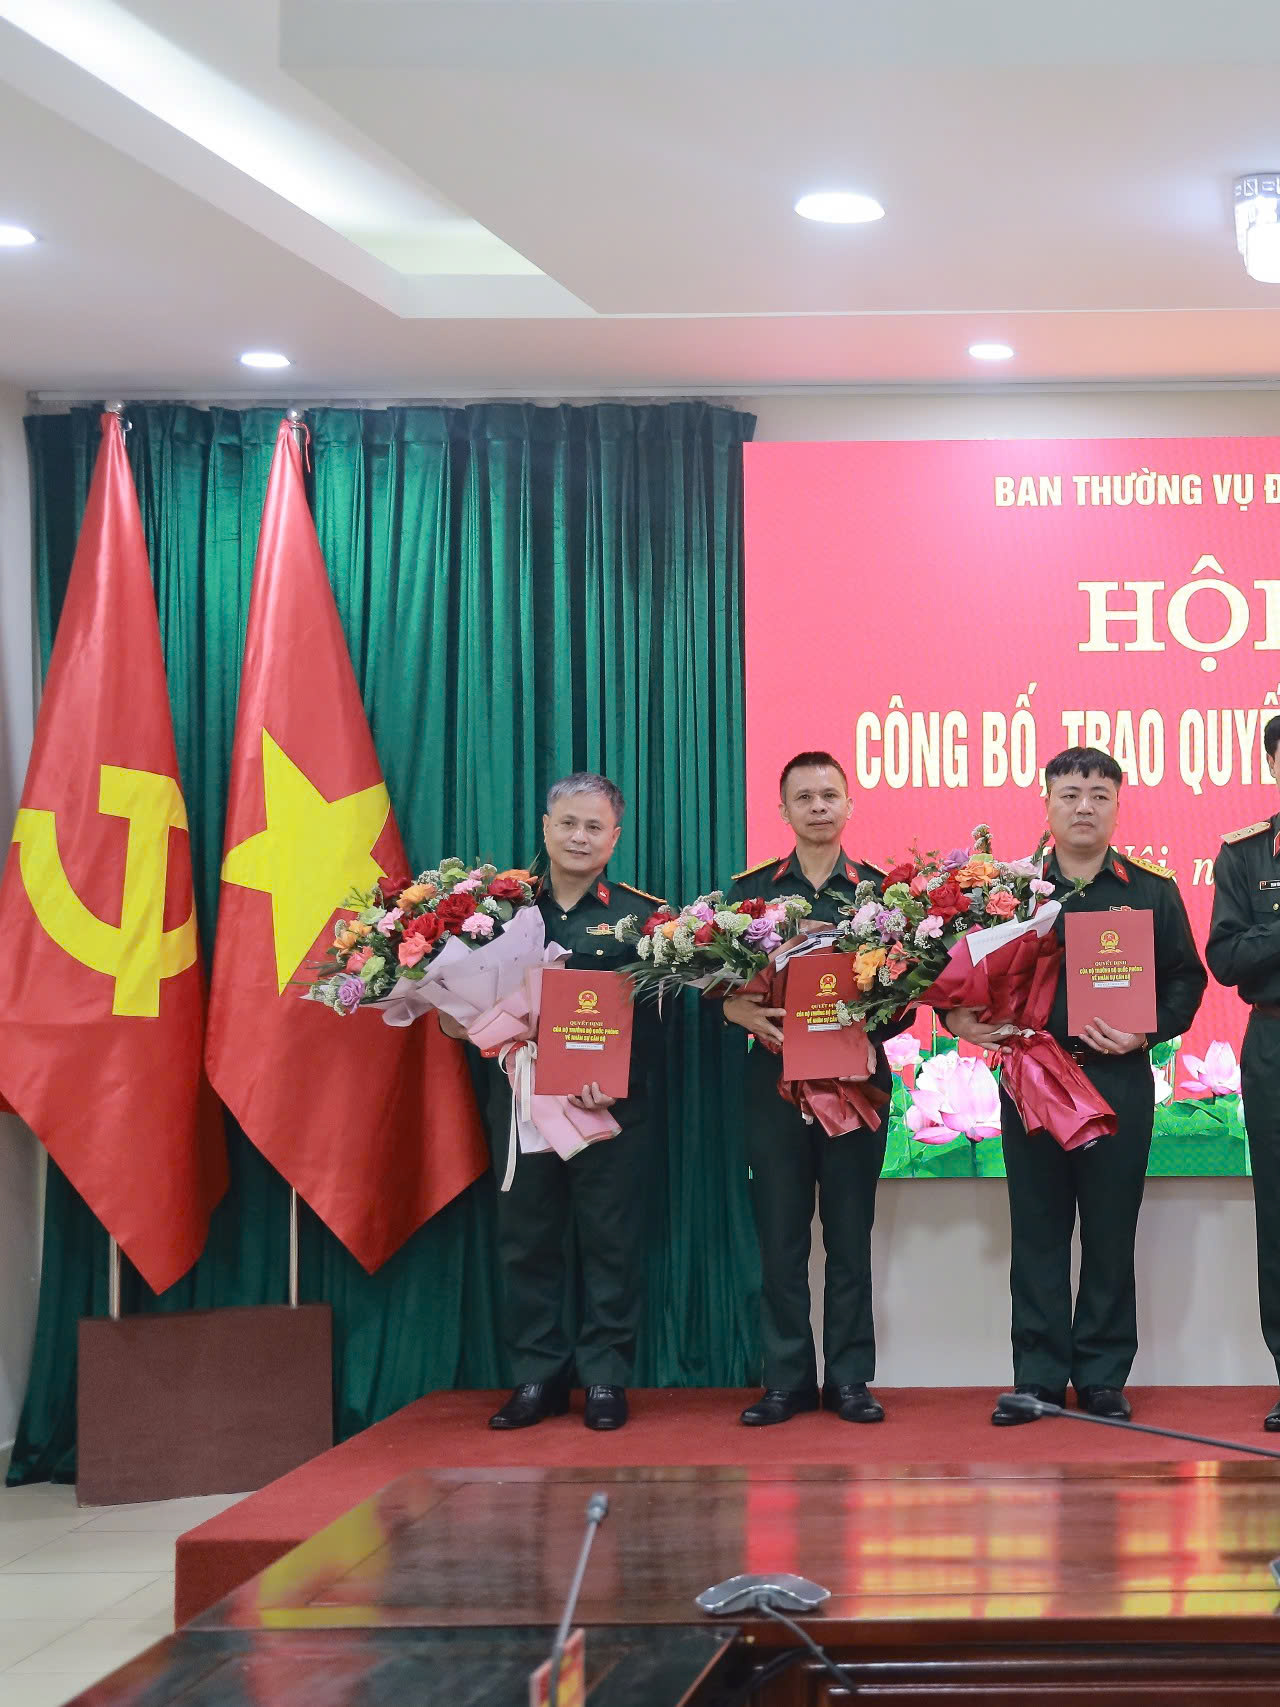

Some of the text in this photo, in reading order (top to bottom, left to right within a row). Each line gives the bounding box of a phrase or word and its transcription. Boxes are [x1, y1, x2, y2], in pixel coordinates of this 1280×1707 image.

[994, 475, 1062, 507] BAN
[1072, 467, 1203, 506] THƯỜNG
[1212, 473, 1254, 512] VỤ
[855, 694, 968, 789] CÔNG
